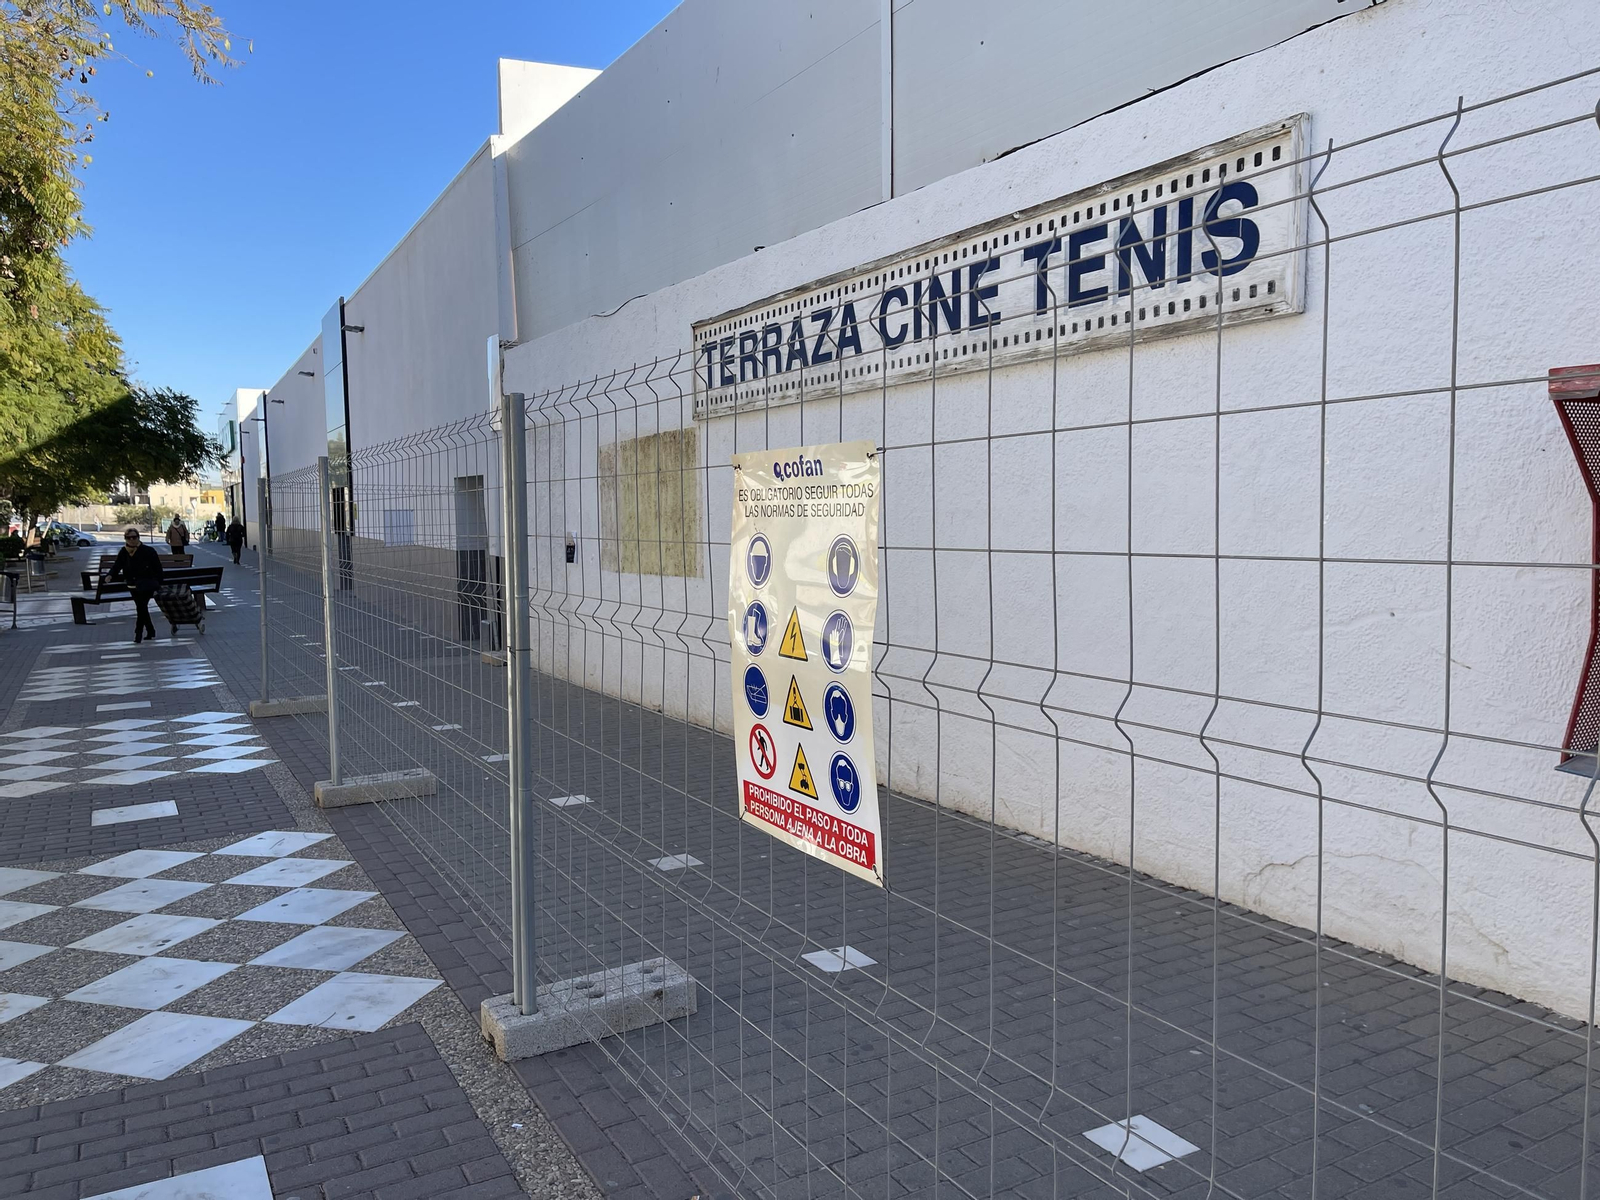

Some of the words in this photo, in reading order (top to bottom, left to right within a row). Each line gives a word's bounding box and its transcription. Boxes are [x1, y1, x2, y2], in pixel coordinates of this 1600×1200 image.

[702, 300, 862, 389] TERRAZA
[879, 255, 1001, 350] CINE
[1024, 181, 1260, 316] TENIS
[783, 454, 824, 479] cofan
[738, 489, 749, 502] ES
[750, 486, 803, 502] OBLIGATORIO
[805, 485, 838, 500] SEGUIR
[841, 483, 874, 500] TODAS
[745, 504, 759, 518] LAS
[761, 503, 795, 518] NORMAS
[797, 504, 809, 518] DE
[811, 502, 866, 518] SEGURIDAD
[749, 784, 792, 813] PROHIBIDO
[794, 803, 805, 819] EL
[806, 810, 831, 831] PASO
[832, 820, 839, 834] A
[841, 823, 869, 847] TODA
[750, 800, 785, 828] PERSONA
[786, 818, 814, 839] AJENA
[816, 831, 823, 846] A
[824, 833, 836, 852] LA
[838, 840, 868, 866] OBRA
